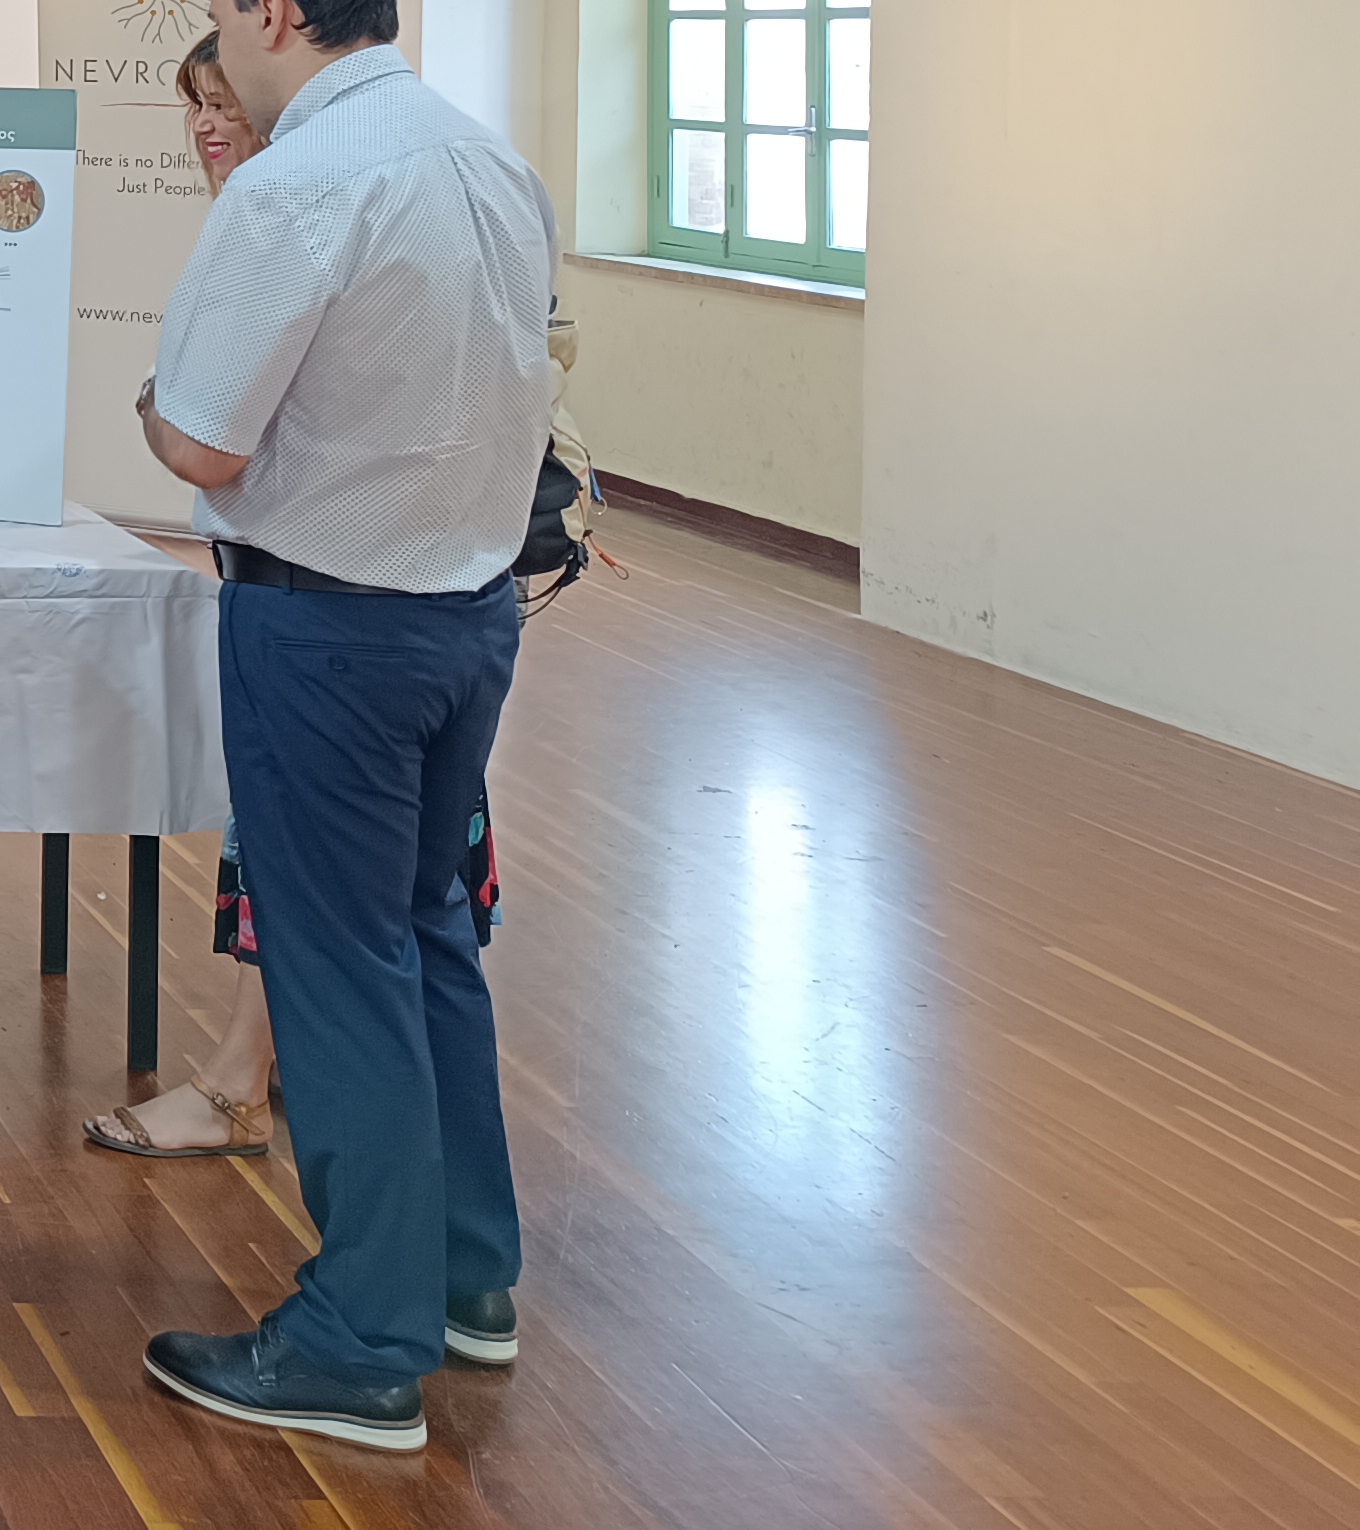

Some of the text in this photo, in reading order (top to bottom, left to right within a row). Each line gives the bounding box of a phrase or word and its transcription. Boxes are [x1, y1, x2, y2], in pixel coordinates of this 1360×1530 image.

[55, 58, 181, 87] NEVRO
[118, 154, 129, 168] is
[135, 158, 153, 169] no
[160, 152, 202, 170] Differ
[116, 176, 206, 198] Just People
[77, 307, 164, 324] www.nev
